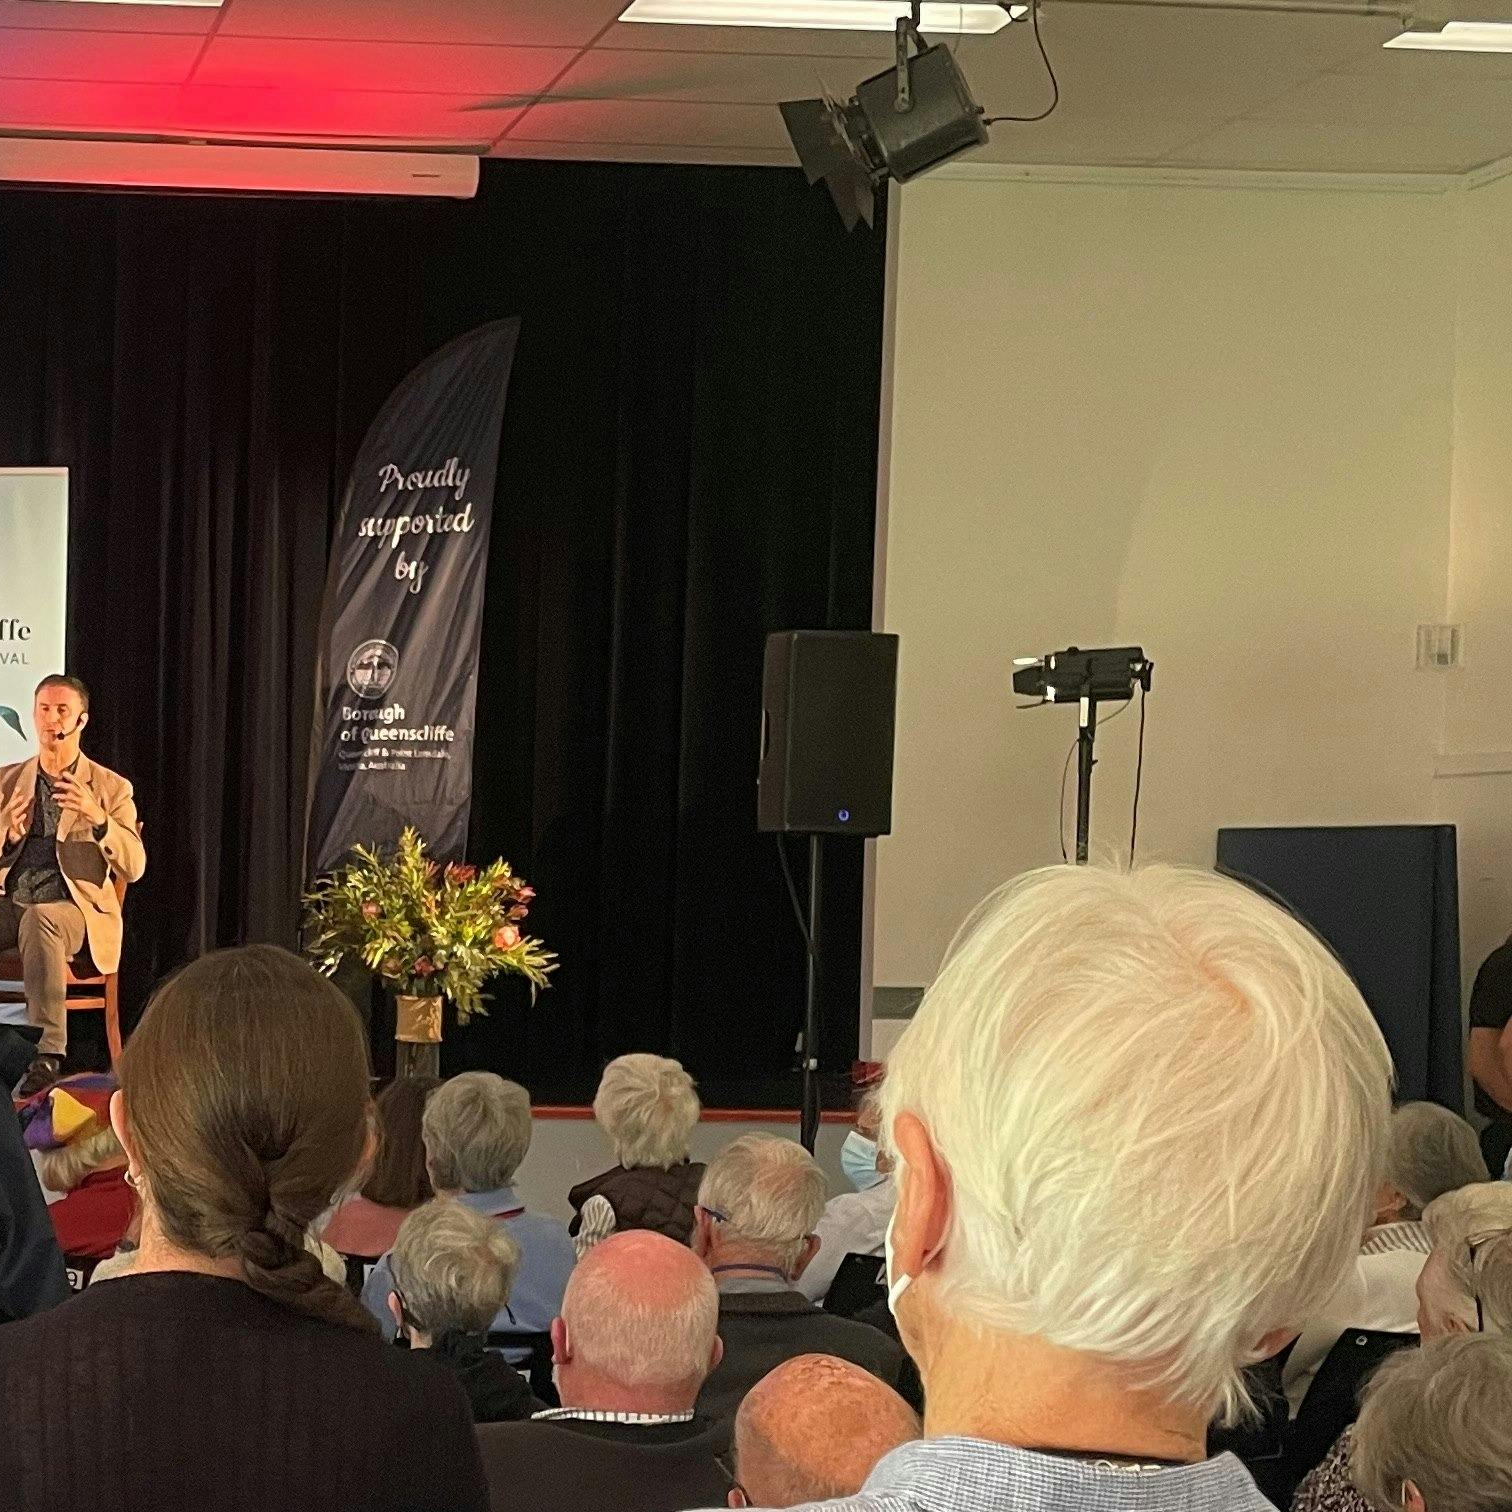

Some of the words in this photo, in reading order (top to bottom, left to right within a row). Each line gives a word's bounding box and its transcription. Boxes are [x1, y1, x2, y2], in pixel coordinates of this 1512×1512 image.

[378, 457, 471, 501] Proudly
[357, 502, 476, 549] supported
[394, 550, 430, 595] by
[361, 724, 455, 745] Queenscliffe
